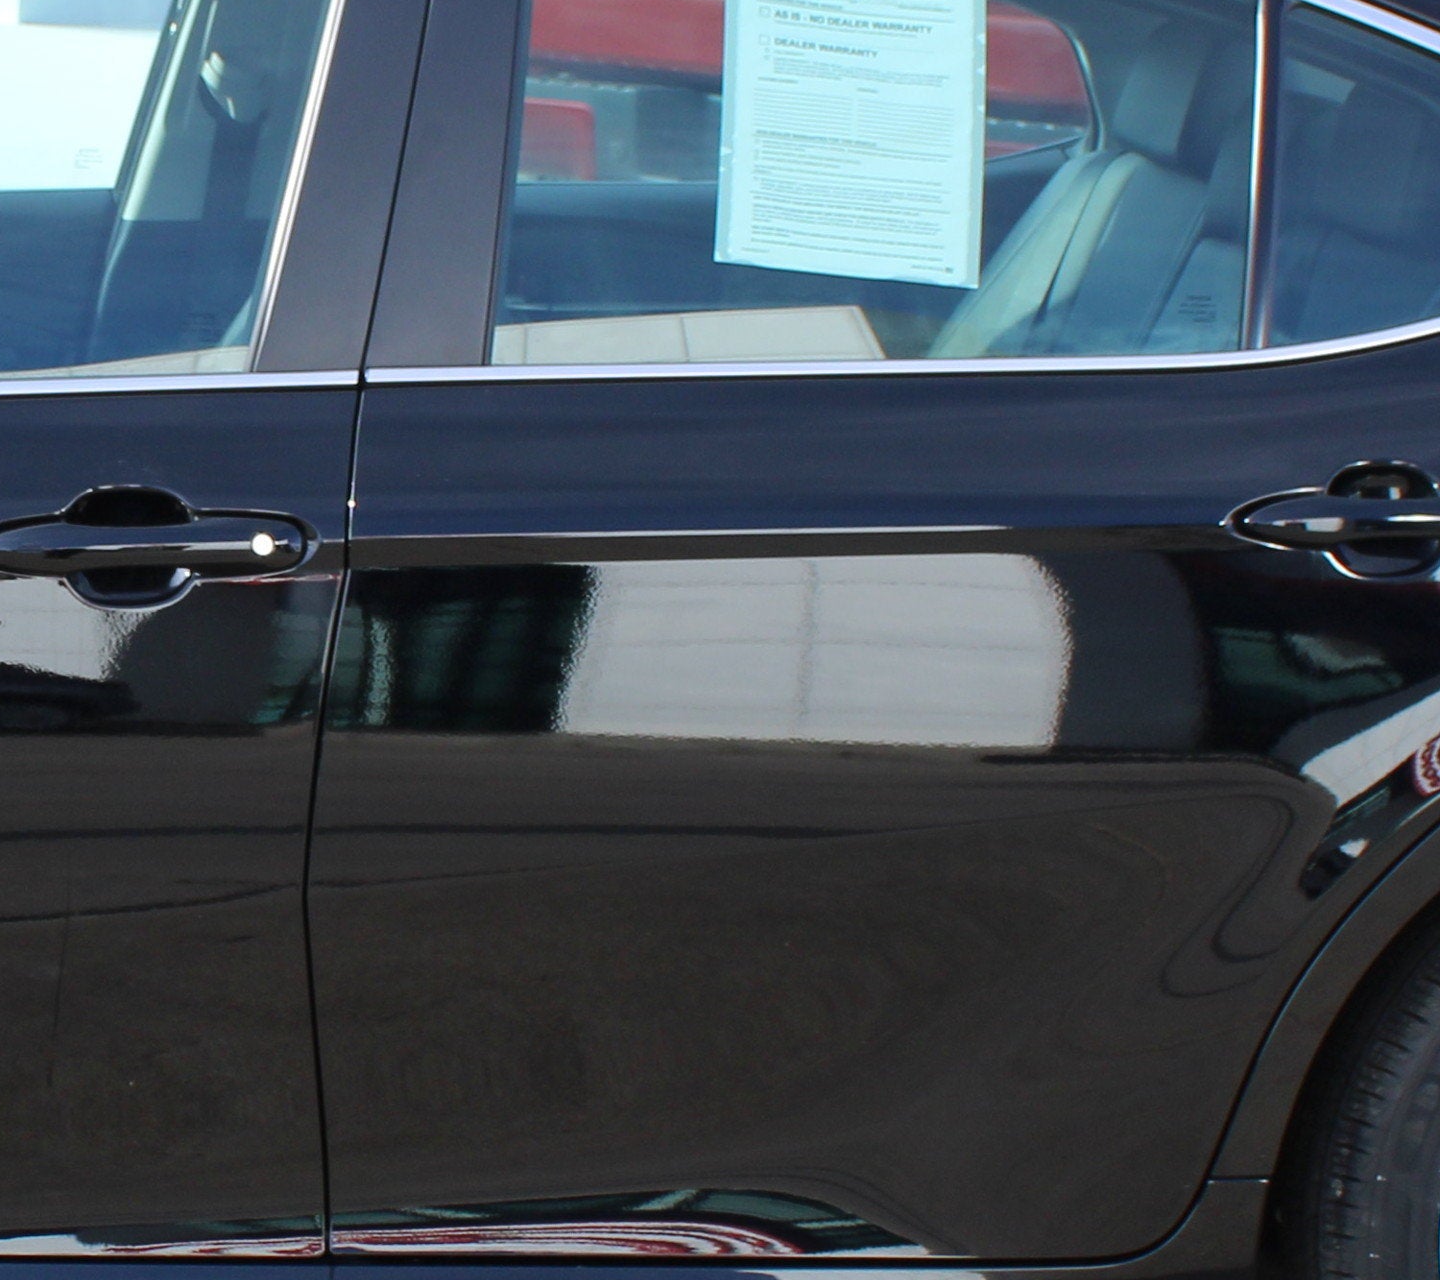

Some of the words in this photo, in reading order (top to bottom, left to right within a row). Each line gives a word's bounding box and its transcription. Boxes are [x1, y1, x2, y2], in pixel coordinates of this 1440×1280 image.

[773, 10, 789, 20] AS
[827, 17, 870, 30] DEALER
[871, 21, 933, 35] WARRANTY
[773, 37, 816, 51] DEALER
[818, 41, 879, 58] WARRANTY
